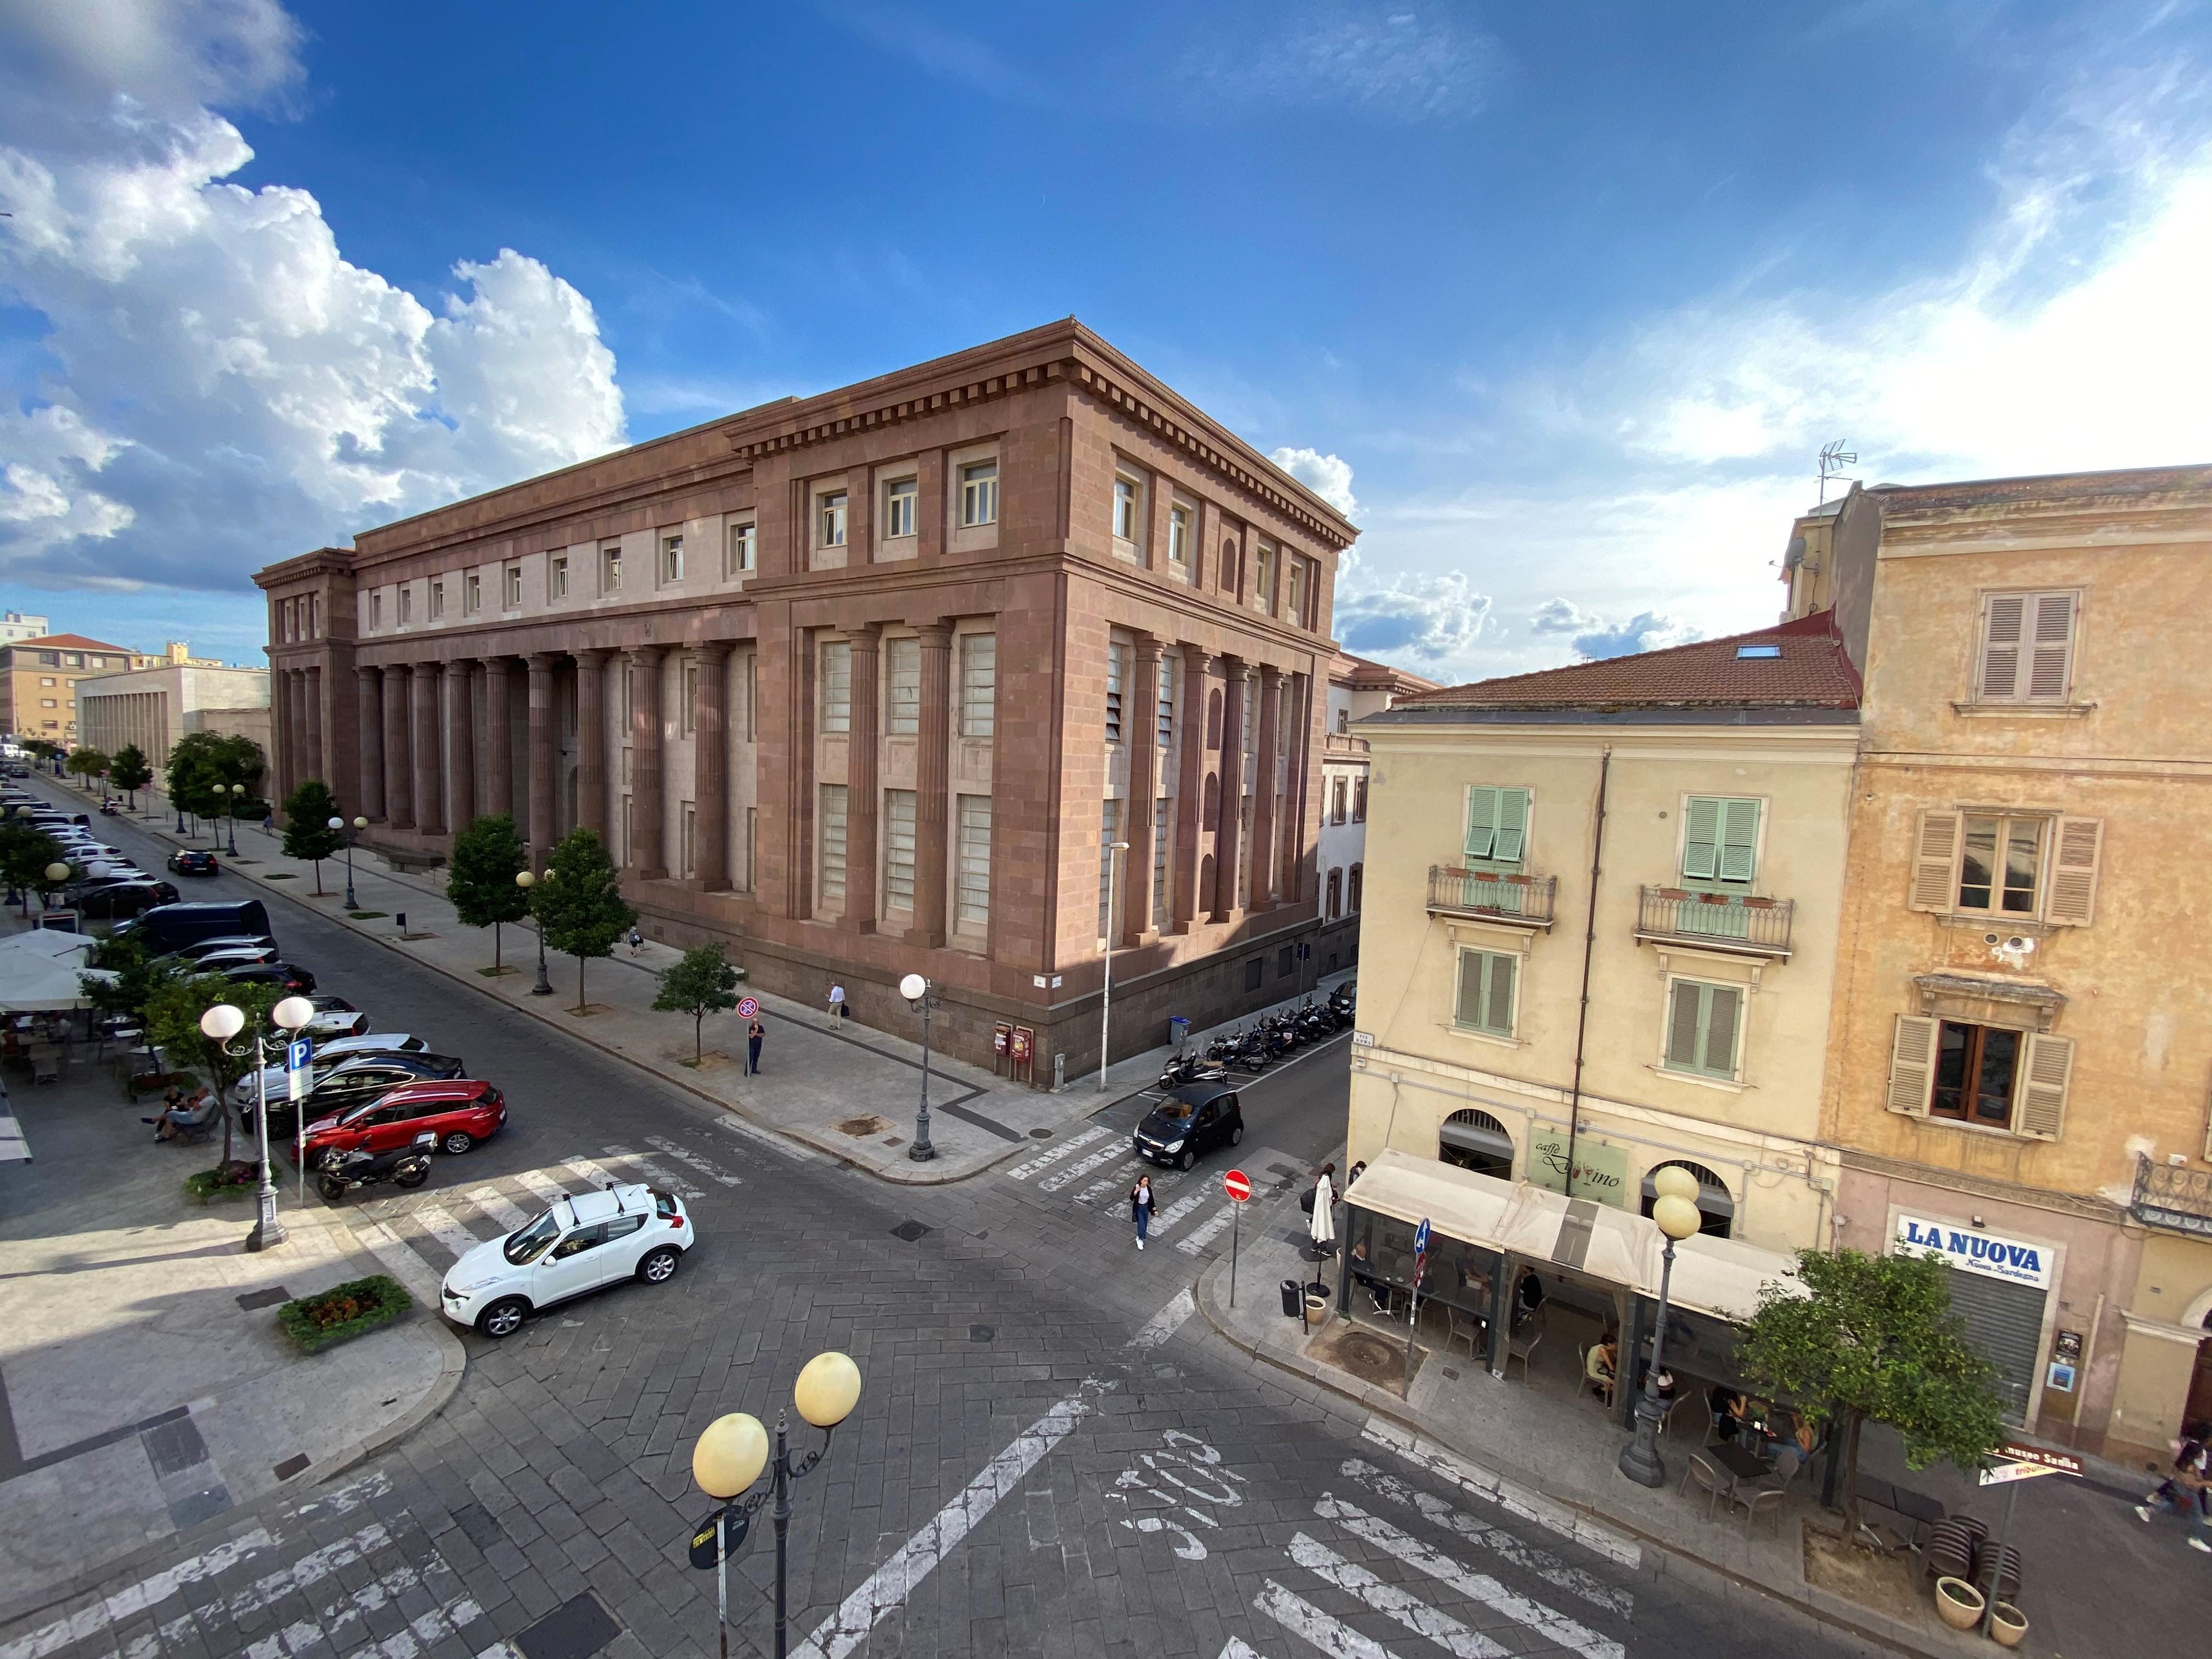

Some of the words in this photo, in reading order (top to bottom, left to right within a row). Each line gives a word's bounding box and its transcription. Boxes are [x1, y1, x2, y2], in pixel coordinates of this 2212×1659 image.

[294, 1043, 307, 1067] P
[1907, 1222, 1943, 1250] LA
[1948, 1231, 2041, 1272] NUOVA
